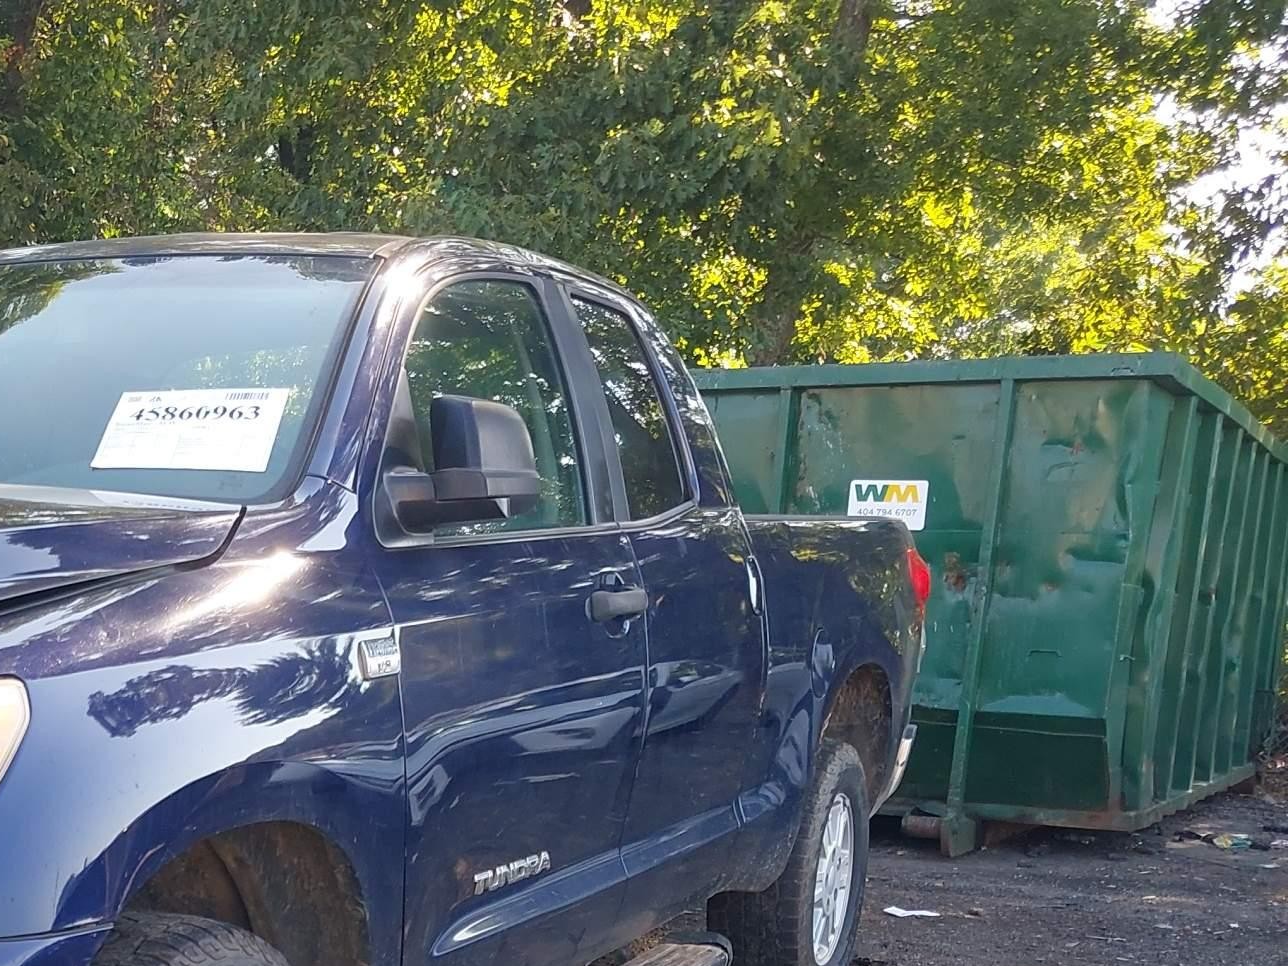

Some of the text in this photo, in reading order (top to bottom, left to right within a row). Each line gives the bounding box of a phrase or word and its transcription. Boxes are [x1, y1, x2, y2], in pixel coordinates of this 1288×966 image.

[130, 405, 261, 421] 45860963
[855, 484, 919, 503] WM
[857, 508, 874, 516] 404
[876, 508, 893, 516] 794
[474, 851, 551, 895] TUNDRA
